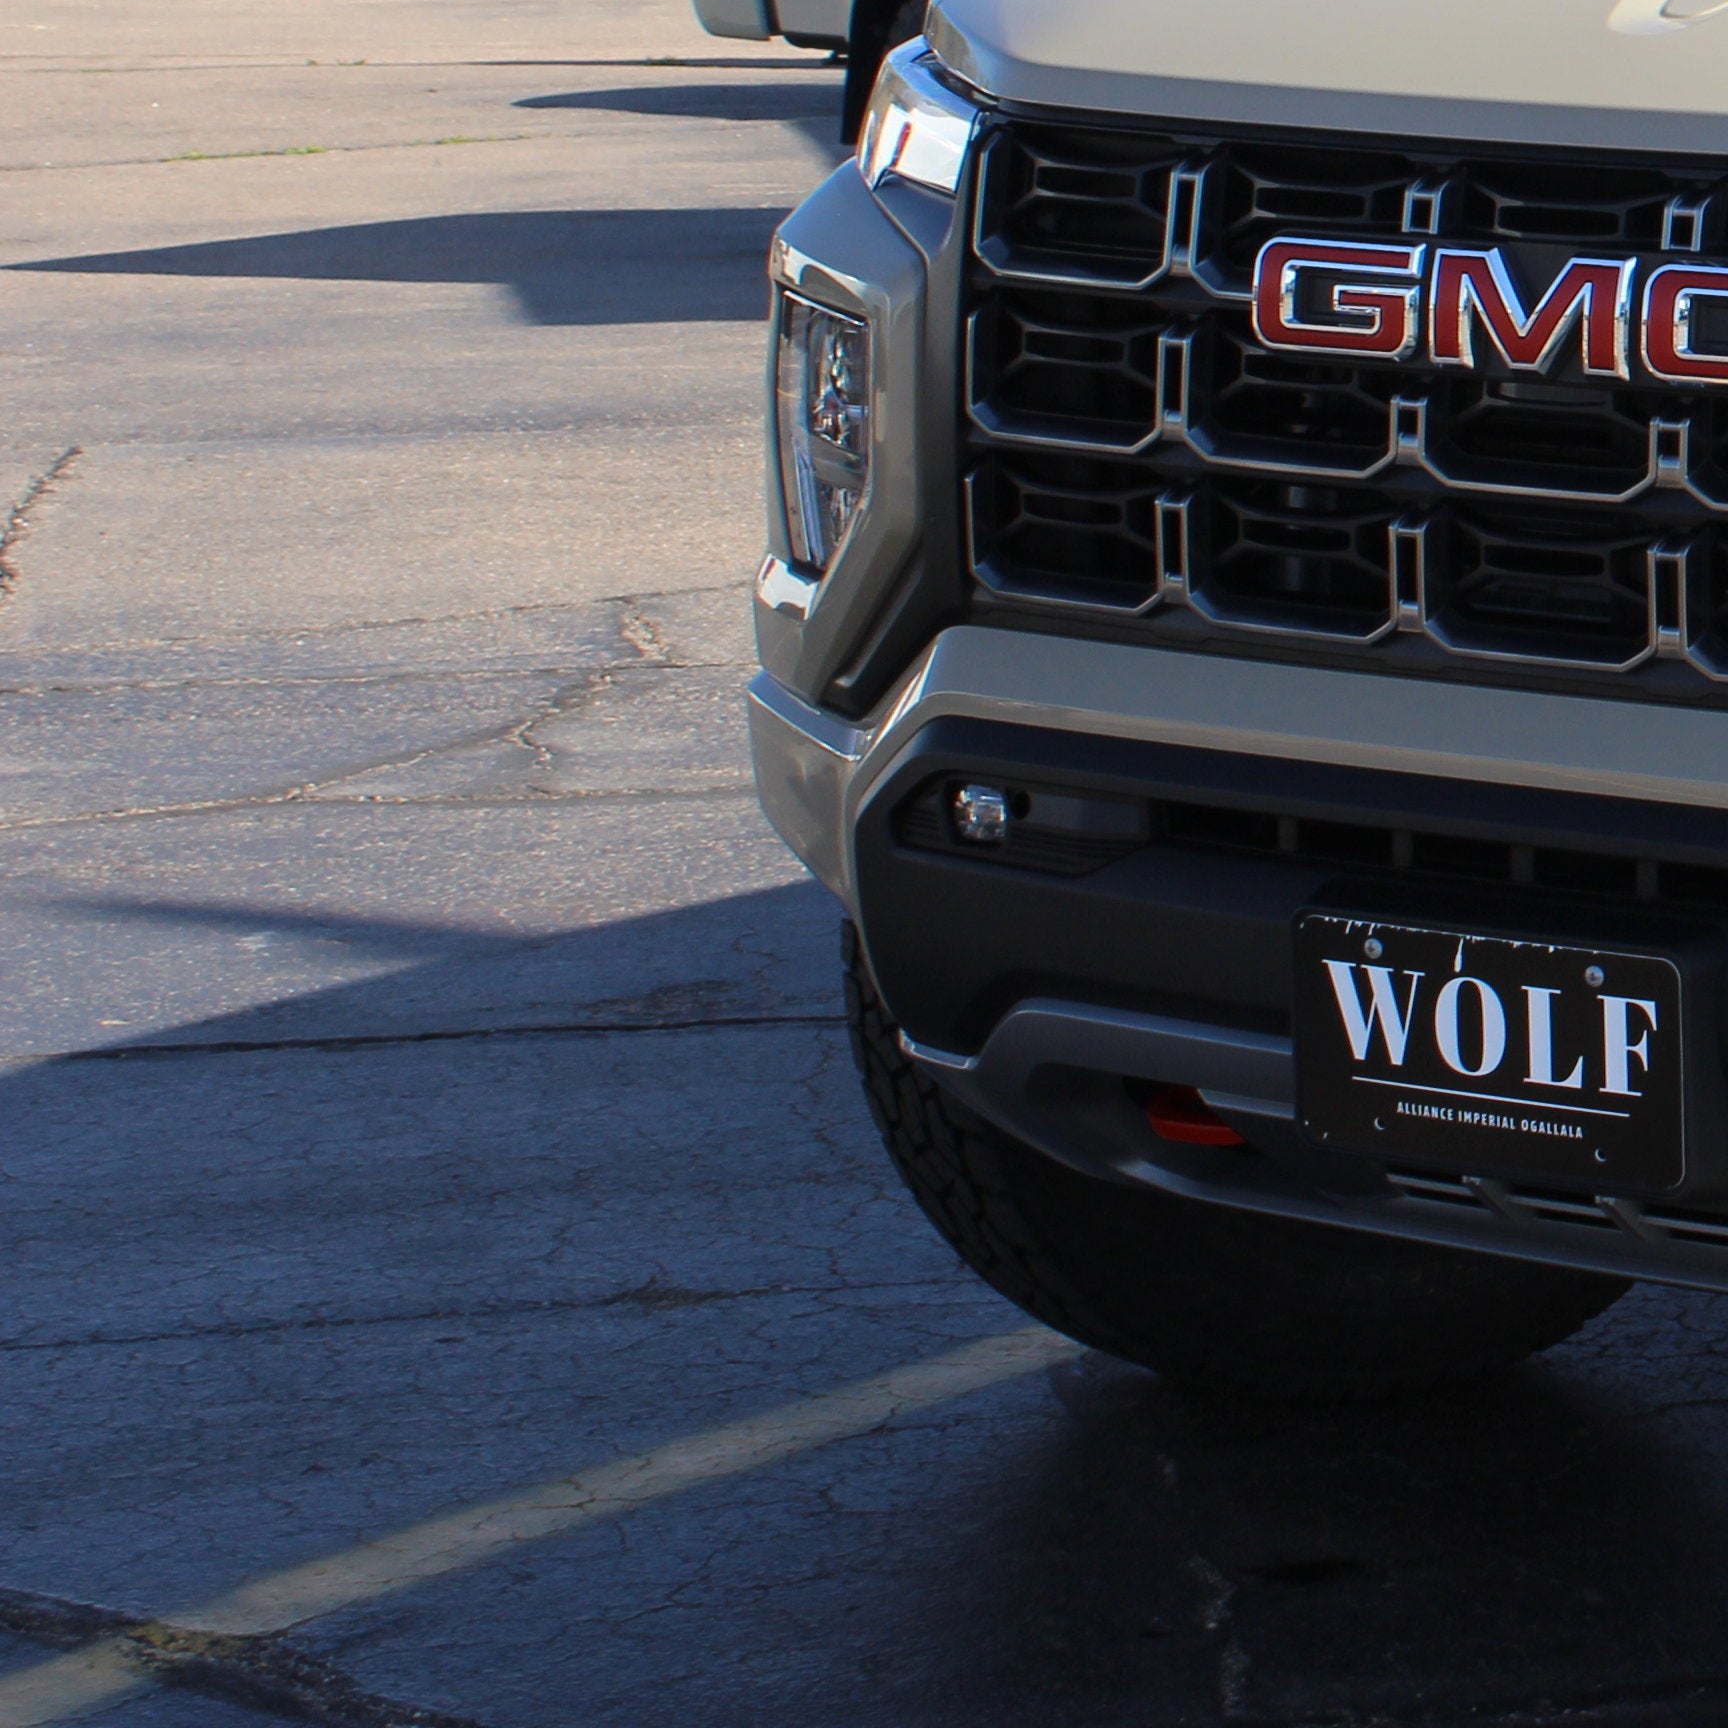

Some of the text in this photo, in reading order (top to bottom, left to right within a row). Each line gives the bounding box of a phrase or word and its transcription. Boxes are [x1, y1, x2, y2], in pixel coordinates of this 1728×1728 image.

[1321, 959, 1658, 1096] WOLF
[1396, 1101, 1584, 1139] ALLIANCE IMPERIAL OGALLALA
